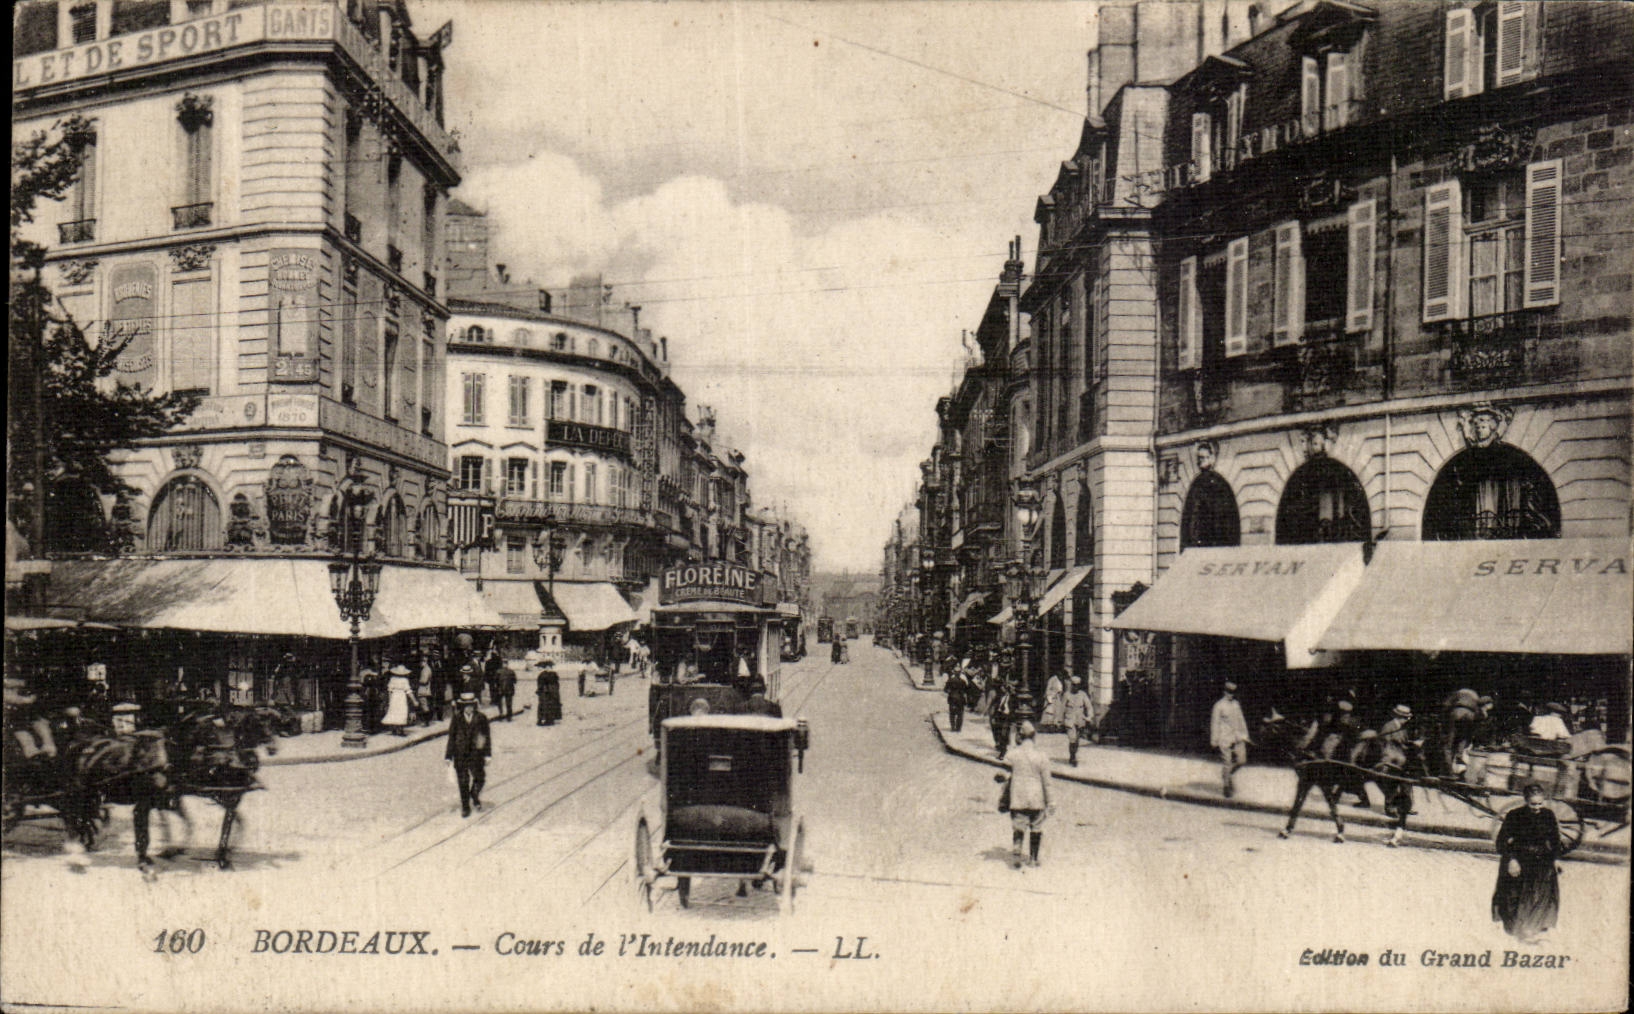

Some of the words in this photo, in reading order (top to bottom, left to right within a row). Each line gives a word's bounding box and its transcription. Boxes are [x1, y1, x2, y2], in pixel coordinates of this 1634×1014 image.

[269, 8, 331, 36] GANTS
[40, 52, 75, 83] ET
[86, 41, 123, 72] DE
[136, 14, 243, 62] SPORT
[563, 424, 585, 443] LA
[271, 509, 306, 521] PARIS
[1198, 561, 1305, 576] SERVAN
